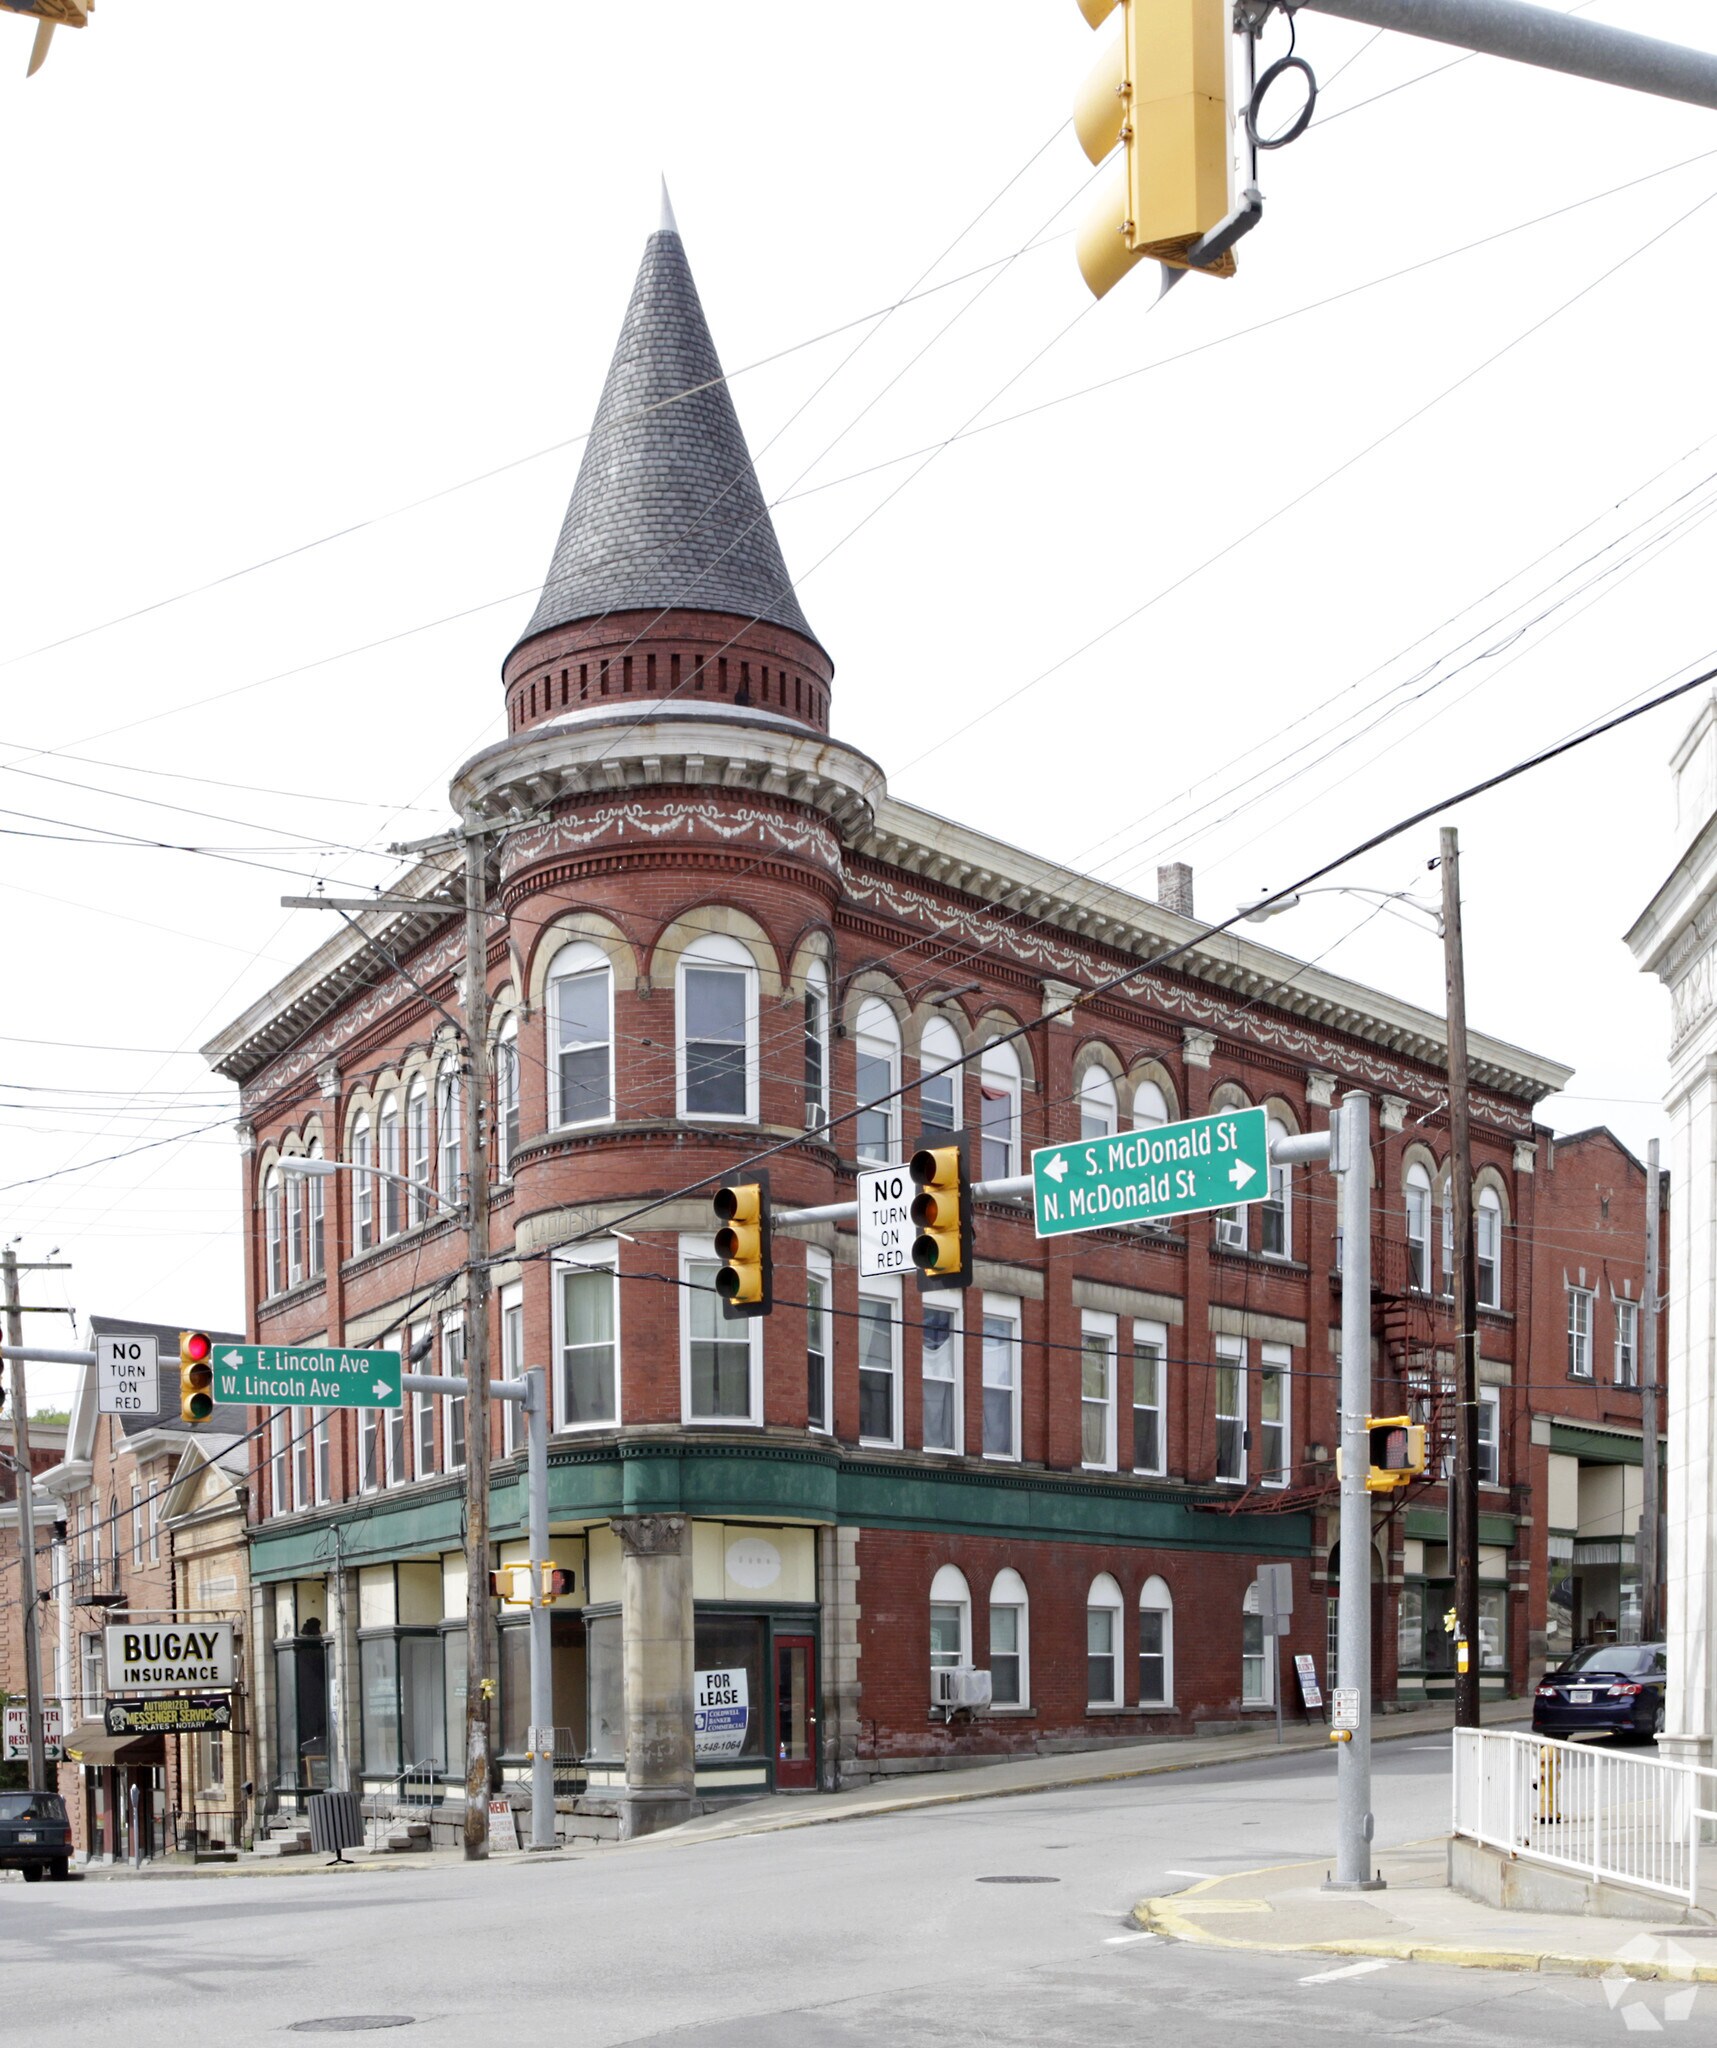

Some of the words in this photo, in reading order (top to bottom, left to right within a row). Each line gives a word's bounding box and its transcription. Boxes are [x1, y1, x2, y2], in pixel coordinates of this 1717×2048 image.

[1085, 1148, 1103, 1176] S.
[1109, 1126, 1211, 1172] McDonald
[1217, 1122, 1238, 1152] St
[875, 1178, 903, 1202] NO
[1044, 1193, 1064, 1221] N.
[1070, 1173, 1170, 1217] McDonald
[1175, 1169, 1196, 1199] St
[872, 1206, 907, 1226] TURN
[881, 1229, 899, 1246] ON
[878, 1250, 903, 1268] RED
[113, 1343, 141, 1360] NO
[257, 1351, 271, 1370] E.
[276, 1352, 335, 1372] Lincoln
[340, 1355, 369, 1373] Ave
[111, 1365, 146, 1377] TURN
[119, 1381, 137, 1393] ON
[221, 1376, 240, 1395] W.
[245, 1376, 305, 1397] Lincoln
[310, 1380, 340, 1398] Ave
[115, 1397, 141, 1409] RED
[124, 1632, 219, 1663] BUGAY
[124, 1666, 218, 1682] INSURANCE
[707, 1674, 730, 1688] FOR
[144, 1700, 189, 1712] AUTHORIZED
[700, 1690, 738, 1706] LEASE
[126, 1710, 178, 1725] MESSENGER
[180, 1708, 215, 1722] SERVICE
[709, 1709, 739, 1717] COLDWELL
[709, 1717, 732, 1725] BANKER
[134, 1722, 170, 1731] T-PLATES
[176, 1721, 206, 1729] NOTARY
[708, 1723, 744, 1731] COMMERCIAL
